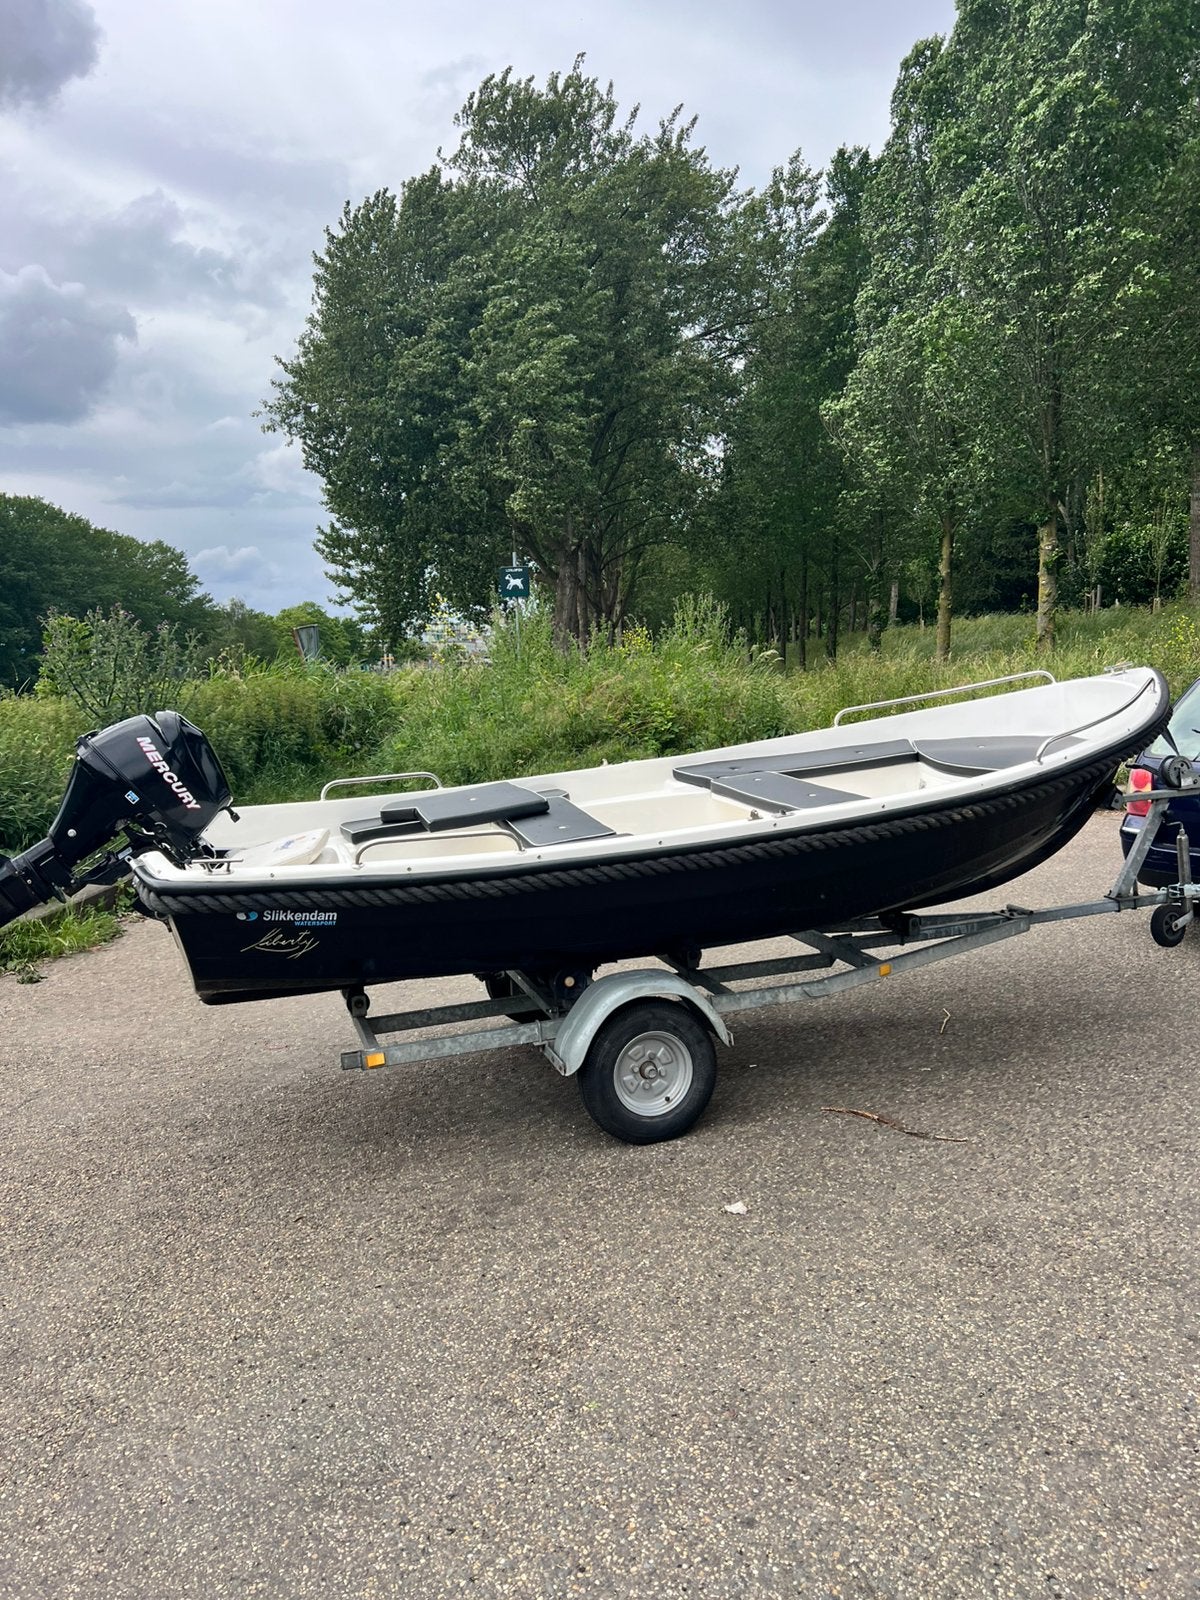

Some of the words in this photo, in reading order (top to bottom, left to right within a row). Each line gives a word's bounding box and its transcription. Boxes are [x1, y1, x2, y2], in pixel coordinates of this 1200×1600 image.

[136, 737, 201, 809] MERCURY
[263, 910, 337, 921] Slikkendam
[240, 927, 320, 959] Liberty
